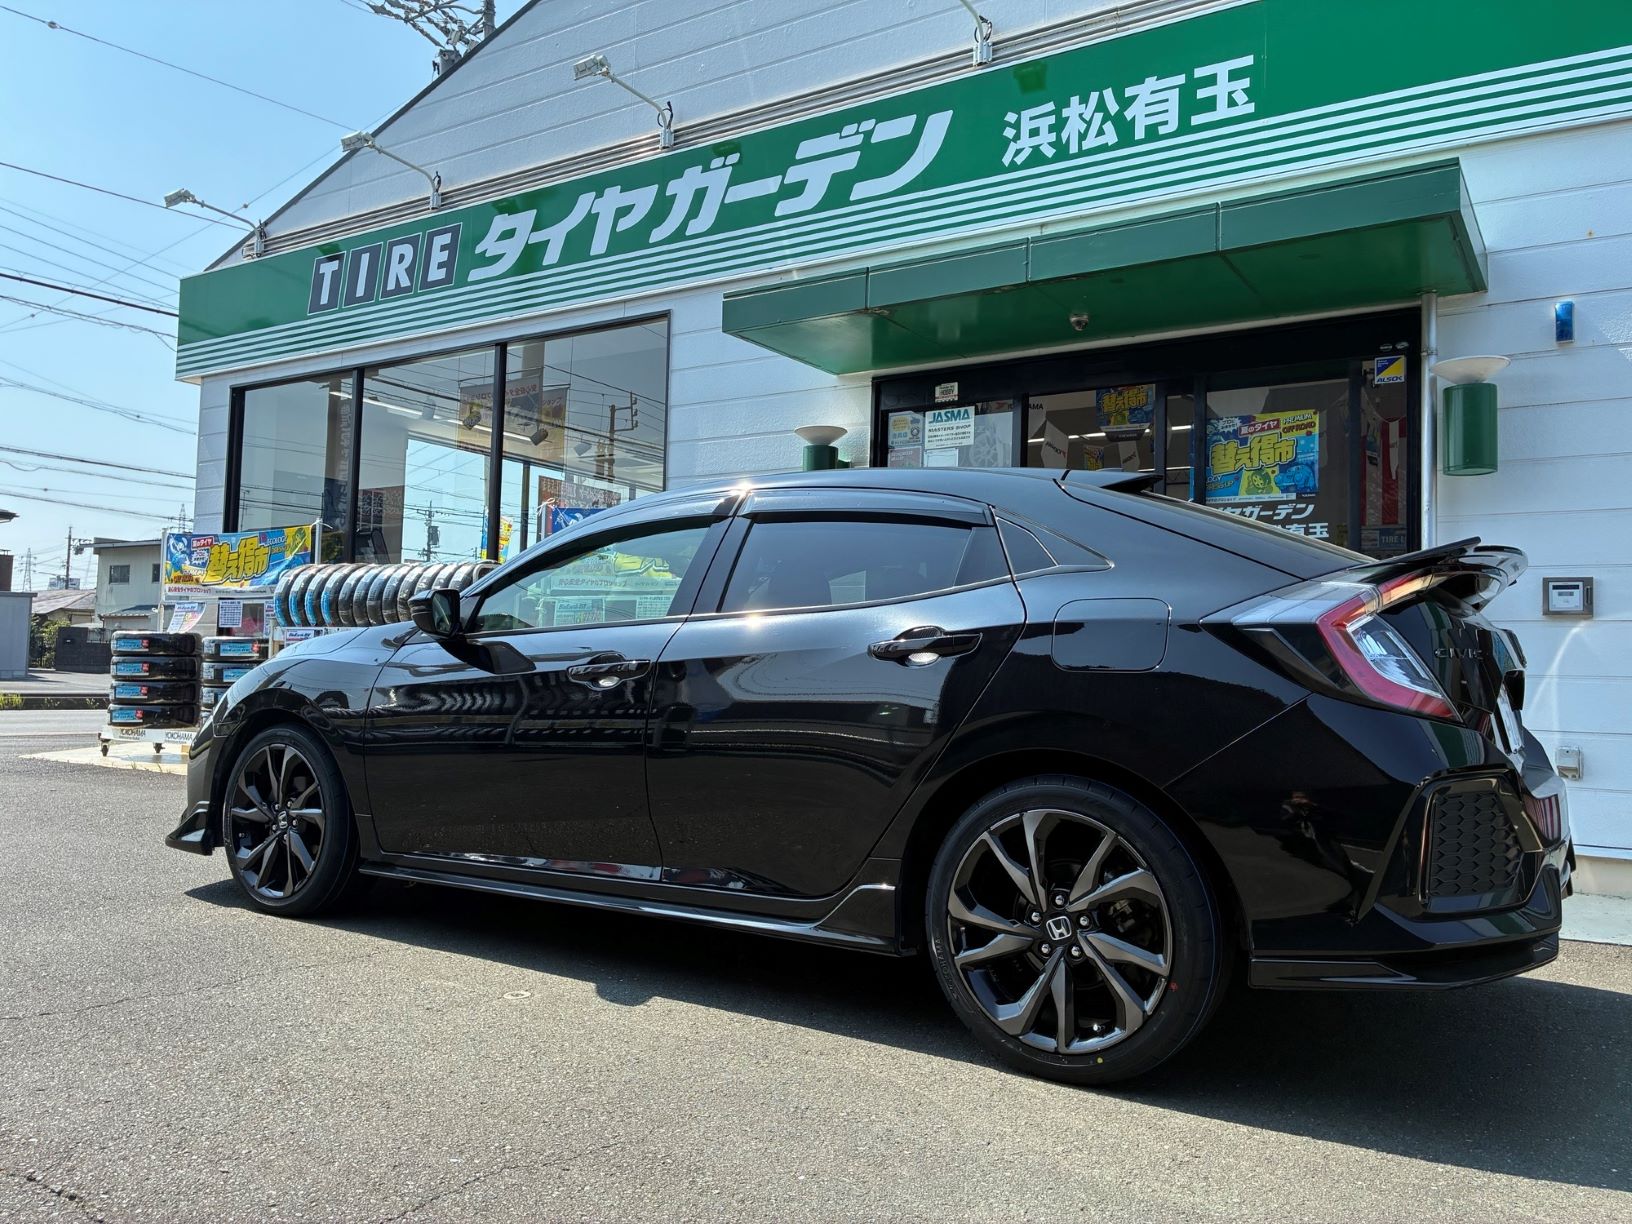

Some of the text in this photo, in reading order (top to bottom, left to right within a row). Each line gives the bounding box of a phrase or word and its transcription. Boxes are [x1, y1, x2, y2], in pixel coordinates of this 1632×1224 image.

[1001, 54, 1257, 168] 浜松有玉
[466, 110, 954, 283] タイヤガーデン
[316, 229, 457, 310] TIRE
[929, 408, 971, 424] JASMA
[1240, 420, 1278, 434] 夏のタイヤ
[1211, 432, 1297, 475] 替え得市
[203, 536, 270, 584] 替え得市
[120, 728, 146, 737] YOKOHAMA
[165, 731, 193, 740] YOKOHAMA
